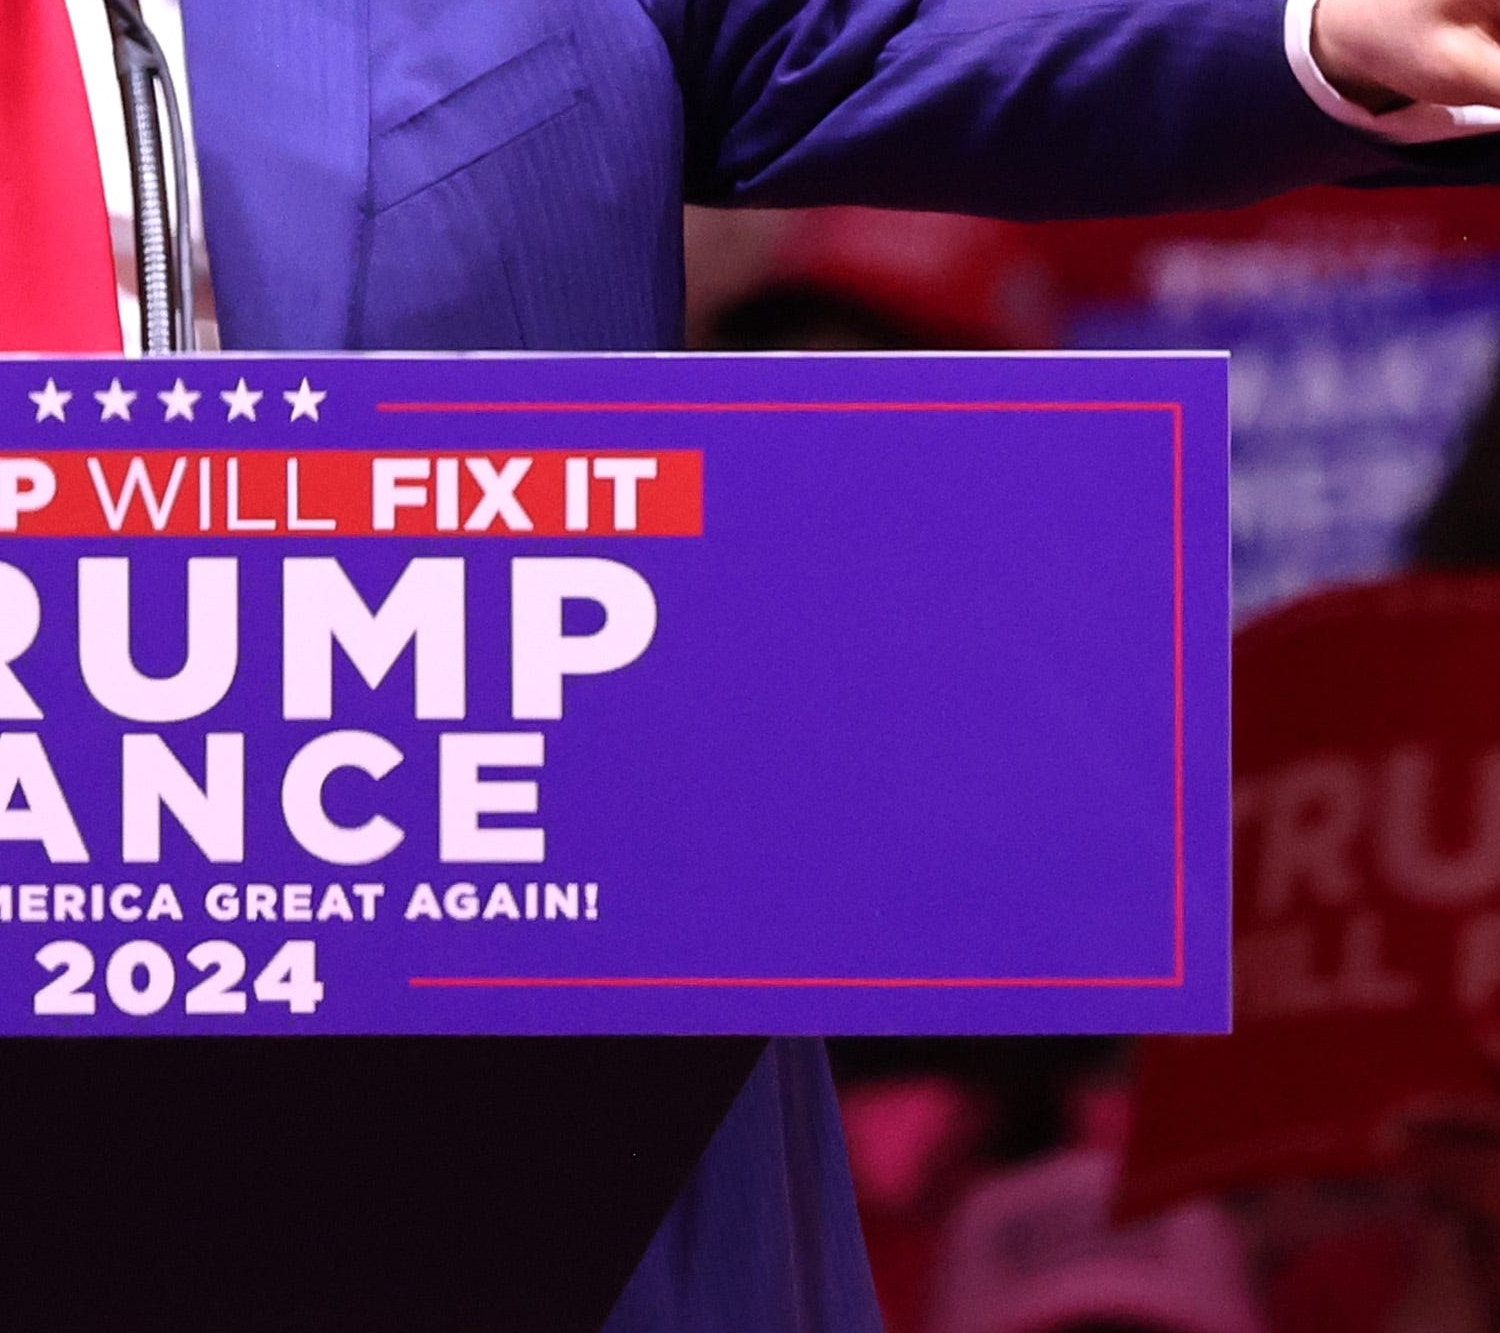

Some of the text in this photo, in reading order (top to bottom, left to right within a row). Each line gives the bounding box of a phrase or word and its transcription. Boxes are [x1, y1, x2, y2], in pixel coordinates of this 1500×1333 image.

[88, 458, 336, 530] WILL
[373, 458, 534, 530] FIX
[566, 458, 657, 530] IT
[205, 884, 384, 921] GREAT
[405, 883, 598, 921] AGAIN!
[34, 940, 323, 1015] 2024
